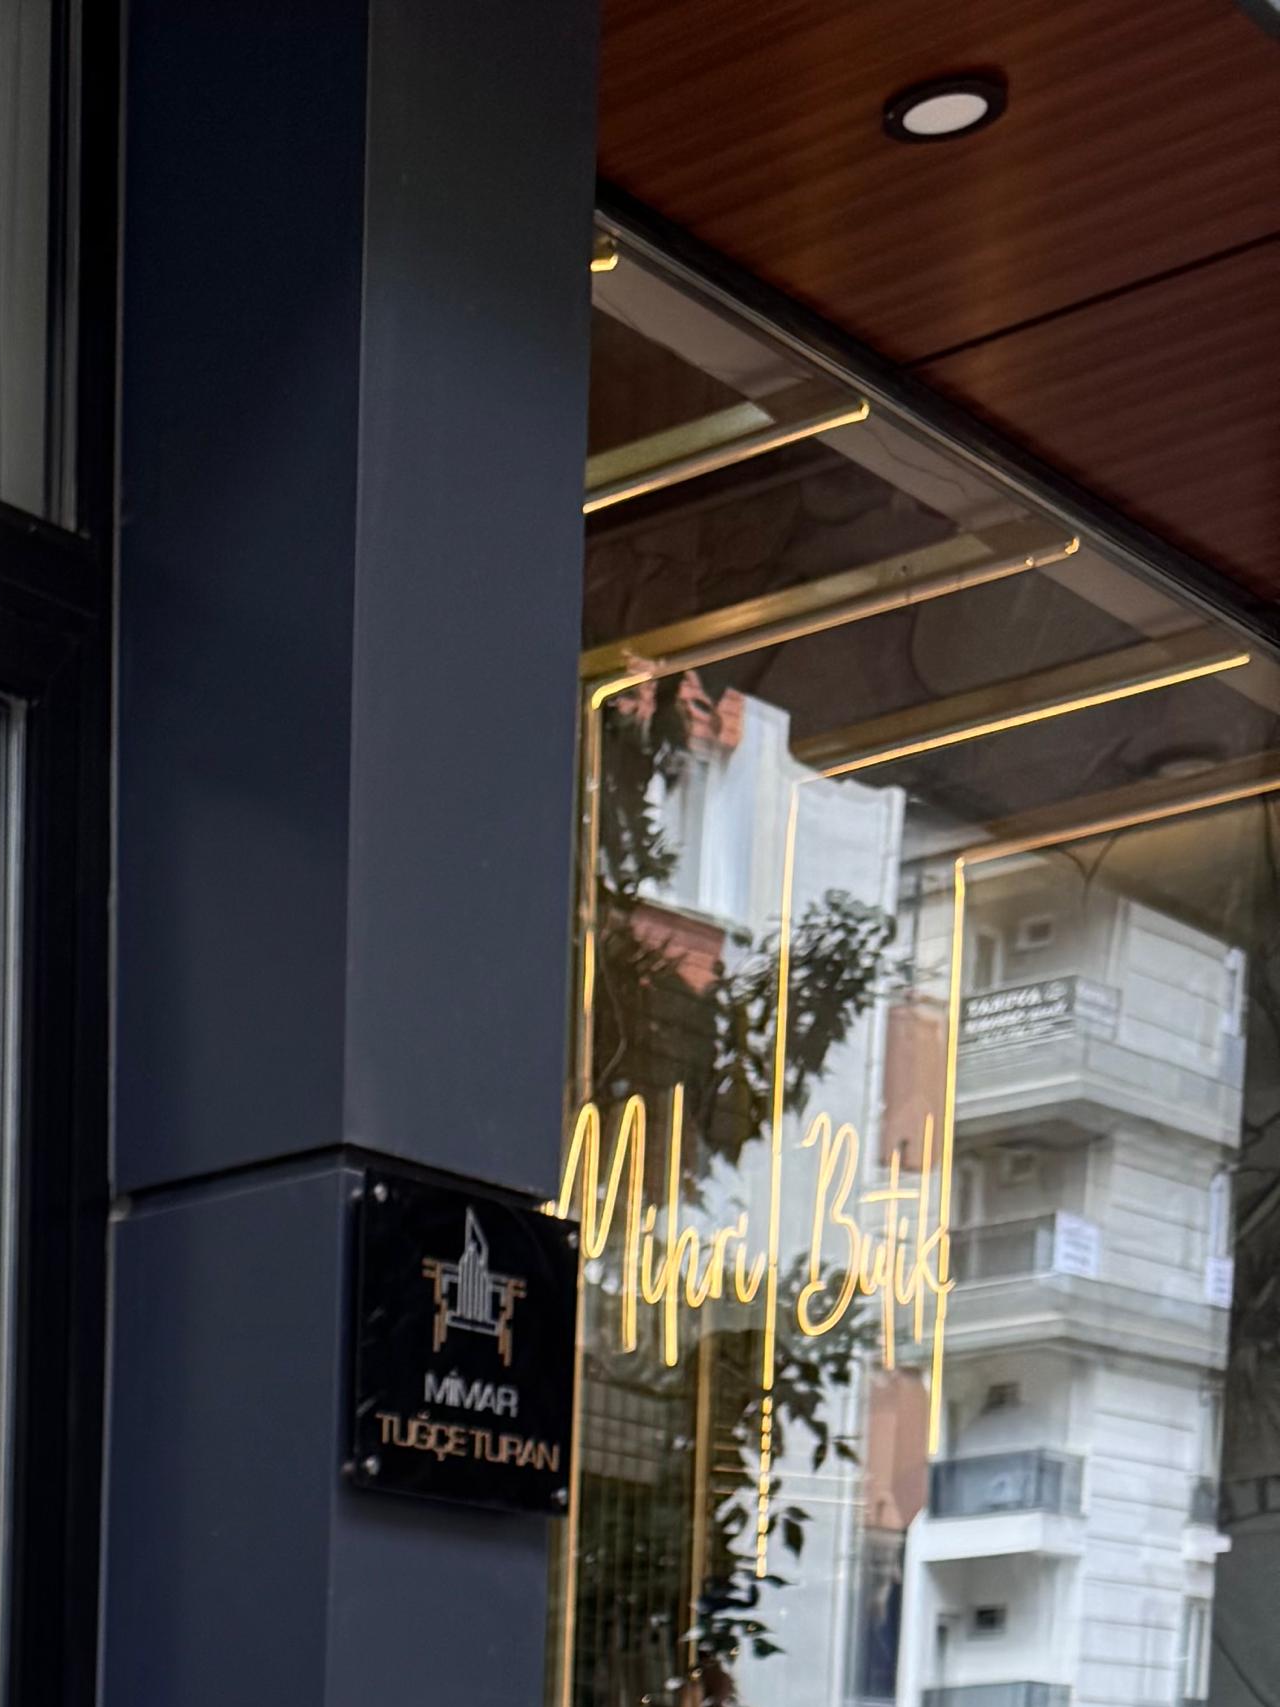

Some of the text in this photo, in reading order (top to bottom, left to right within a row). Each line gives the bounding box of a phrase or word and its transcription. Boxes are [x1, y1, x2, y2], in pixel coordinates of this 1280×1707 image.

[557, 1081, 956, 1370] Mihri Butik
[375, 1412, 561, 1473] TUĞÇE TURAN
